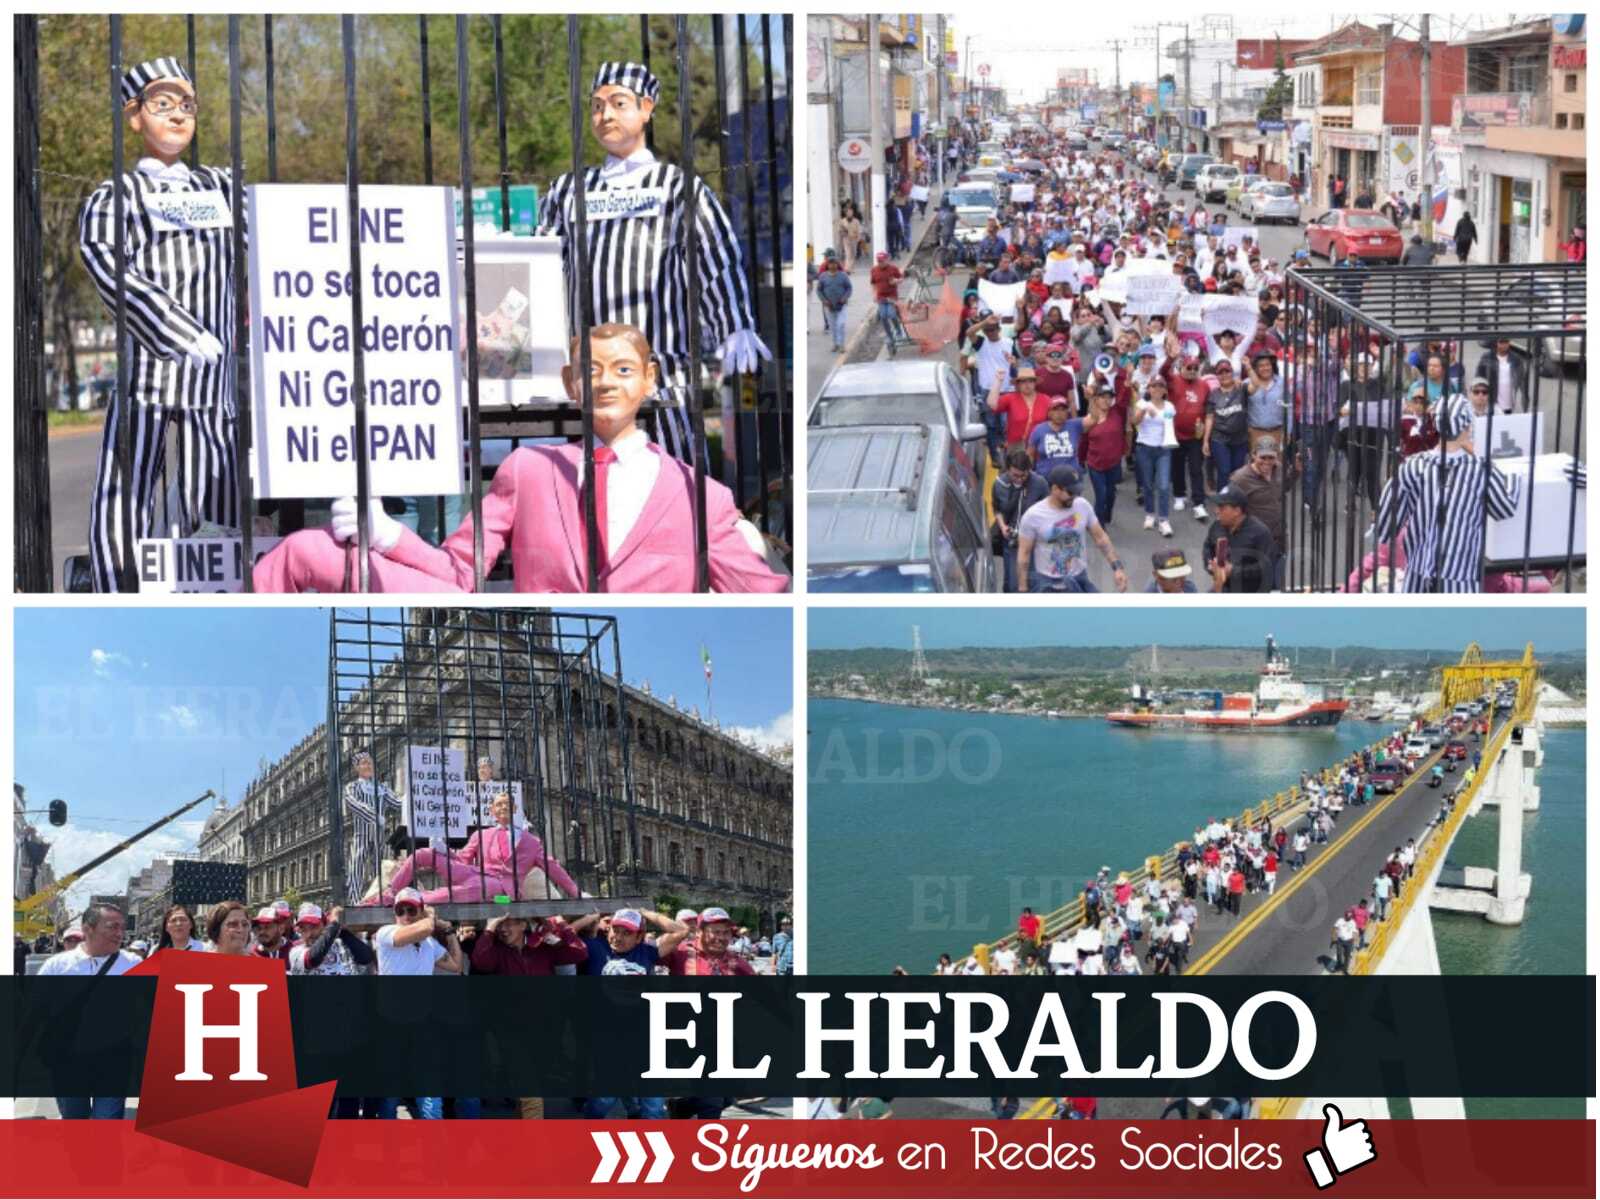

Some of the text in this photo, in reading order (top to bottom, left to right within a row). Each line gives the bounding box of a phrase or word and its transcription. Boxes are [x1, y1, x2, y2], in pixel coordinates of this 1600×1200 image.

[308, 207, 405, 244] El NE
[273, 270, 314, 298] no
[372, 264, 441, 298] toca
[263, 315, 453, 352] Ni Caderón
[279, 370, 442, 407] Ni Gnaro
[287, 424, 436, 462] Ni el PAN
[142, 544, 166, 582] El
[177, 543, 224, 582] INE
[422, 784, 464, 797] Caldrón
